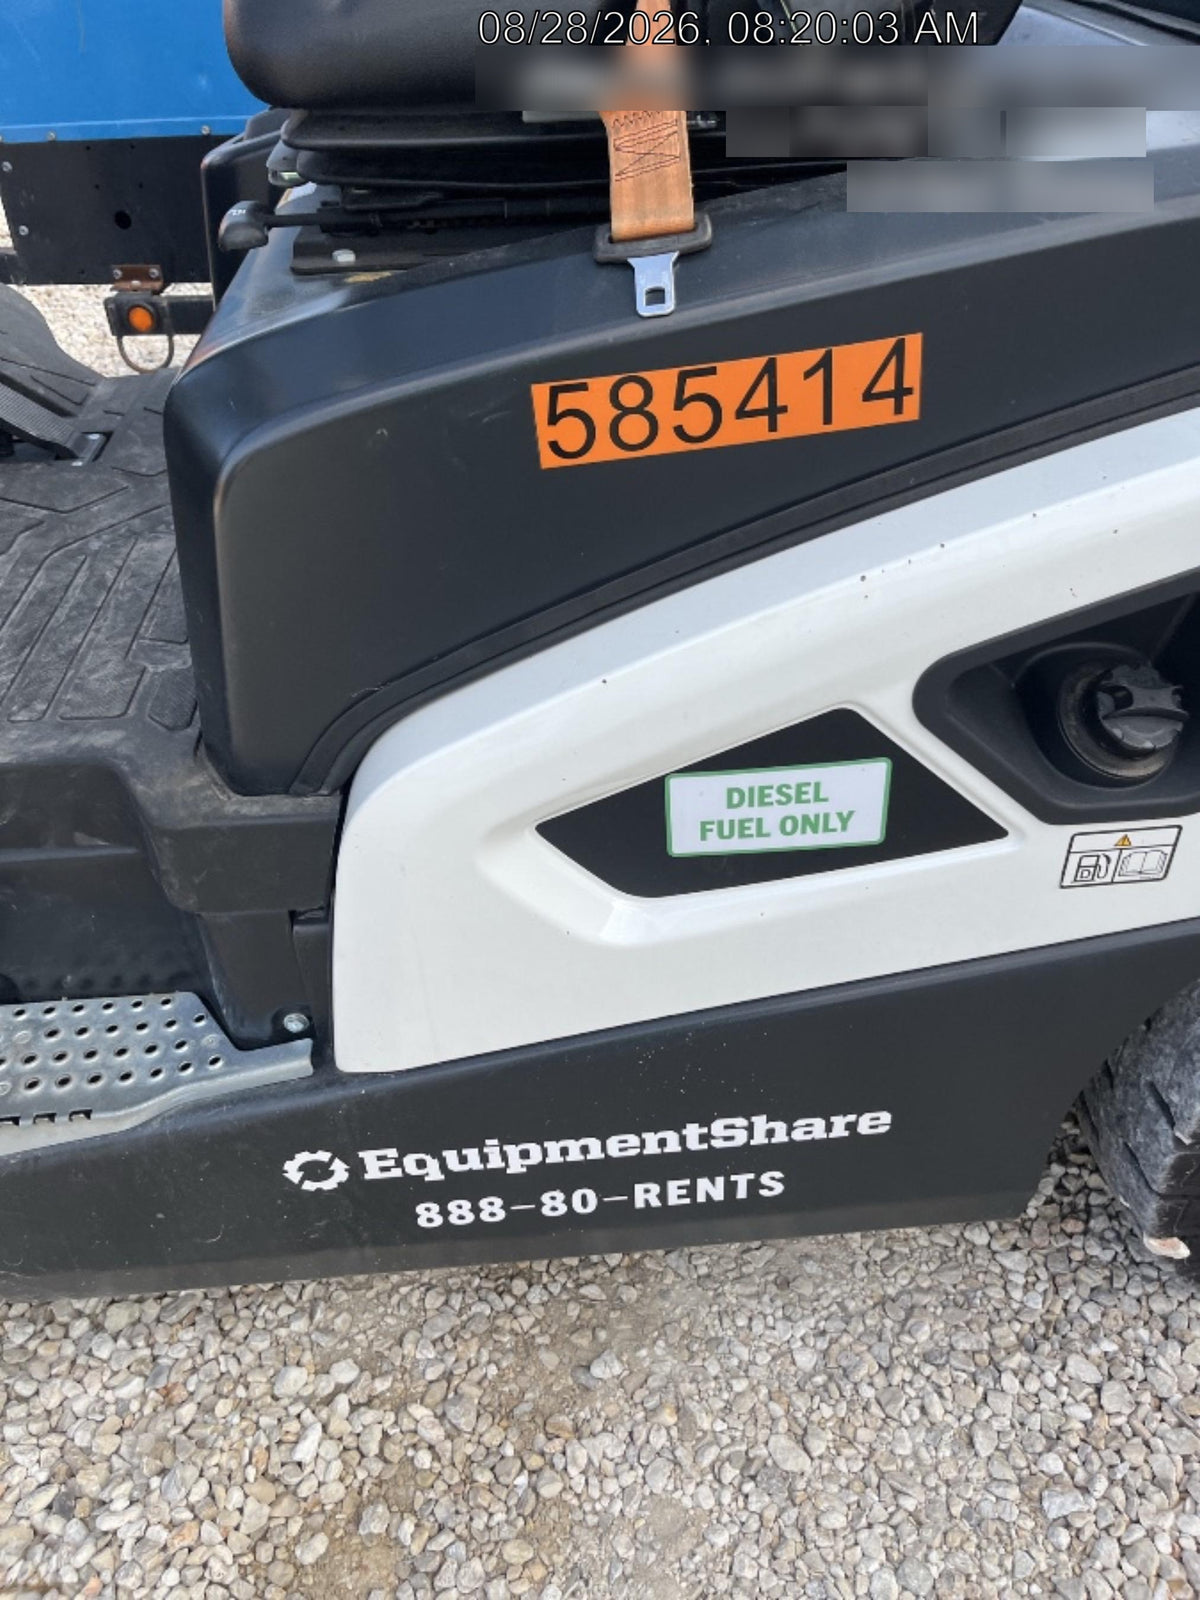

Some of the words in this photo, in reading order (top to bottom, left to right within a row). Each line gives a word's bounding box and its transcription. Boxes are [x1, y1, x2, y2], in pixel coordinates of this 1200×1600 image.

[547, 337, 914, 459] 585414
[726, 781, 829, 809] DIESEL
[700, 817, 771, 841] FUEL
[779, 810, 855, 836] ONLY
[357, 1110, 892, 1182] EquipmentShare
[415, 1170, 785, 1228] 888-80-RENTS
